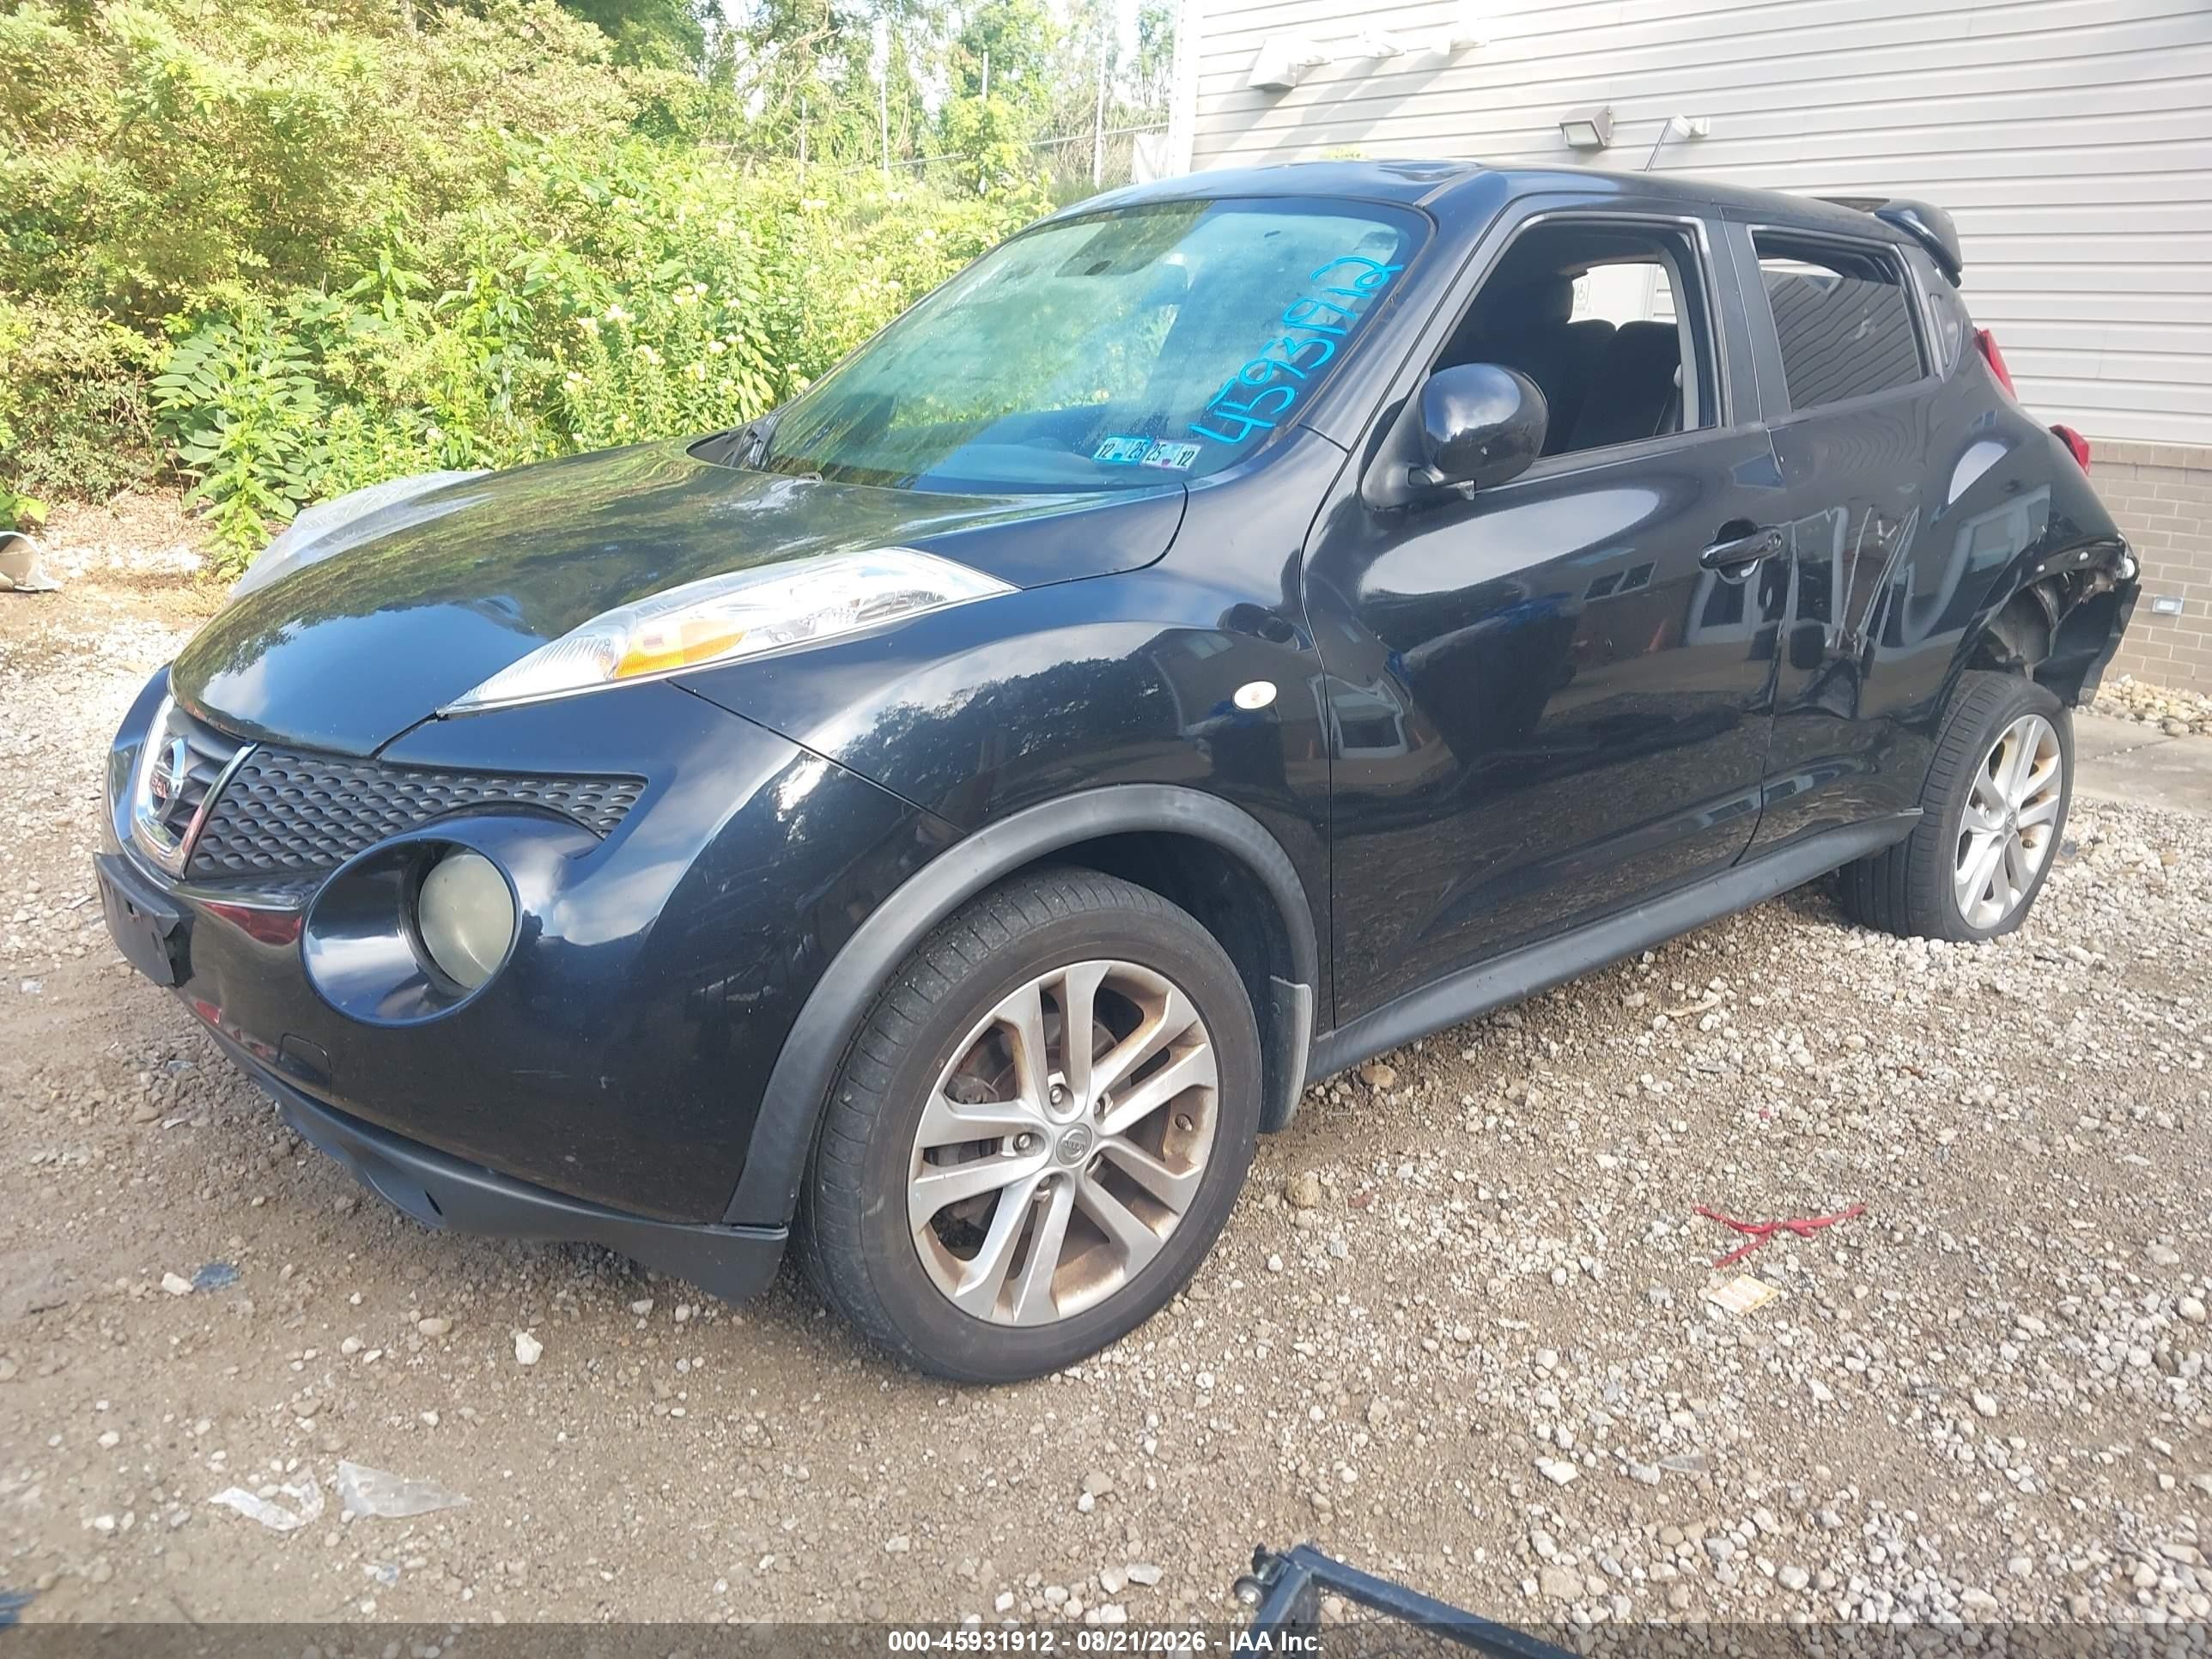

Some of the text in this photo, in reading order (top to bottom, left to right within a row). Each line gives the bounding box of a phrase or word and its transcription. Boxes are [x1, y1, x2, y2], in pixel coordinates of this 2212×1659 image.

[1188, 255, 1403, 443] 45931912
[1097, 442, 1147, 459] 12 25
[1146, 443, 1194, 466] 25 12
